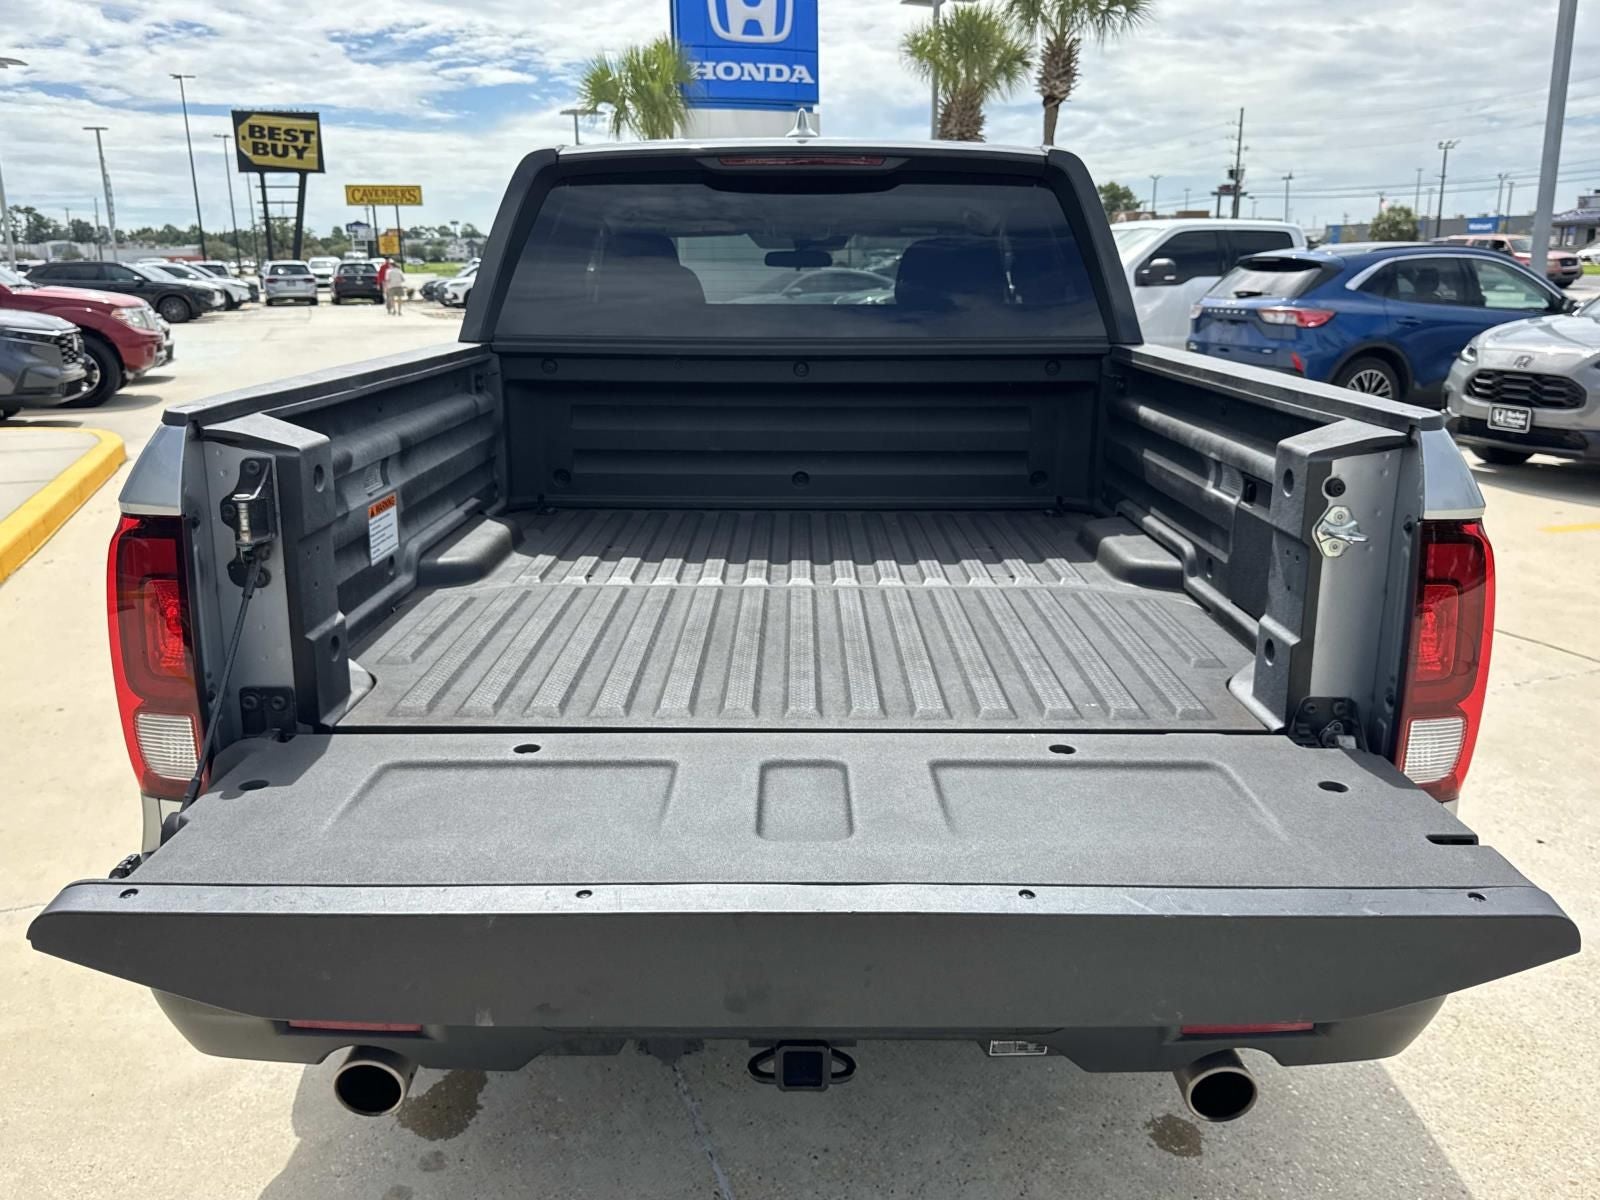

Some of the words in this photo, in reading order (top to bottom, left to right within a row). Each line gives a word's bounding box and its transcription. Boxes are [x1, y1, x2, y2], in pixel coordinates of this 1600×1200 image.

[687, 61, 816, 84] HONDA
[248, 124, 315, 144] BEST
[252, 141, 310, 160] BUY
